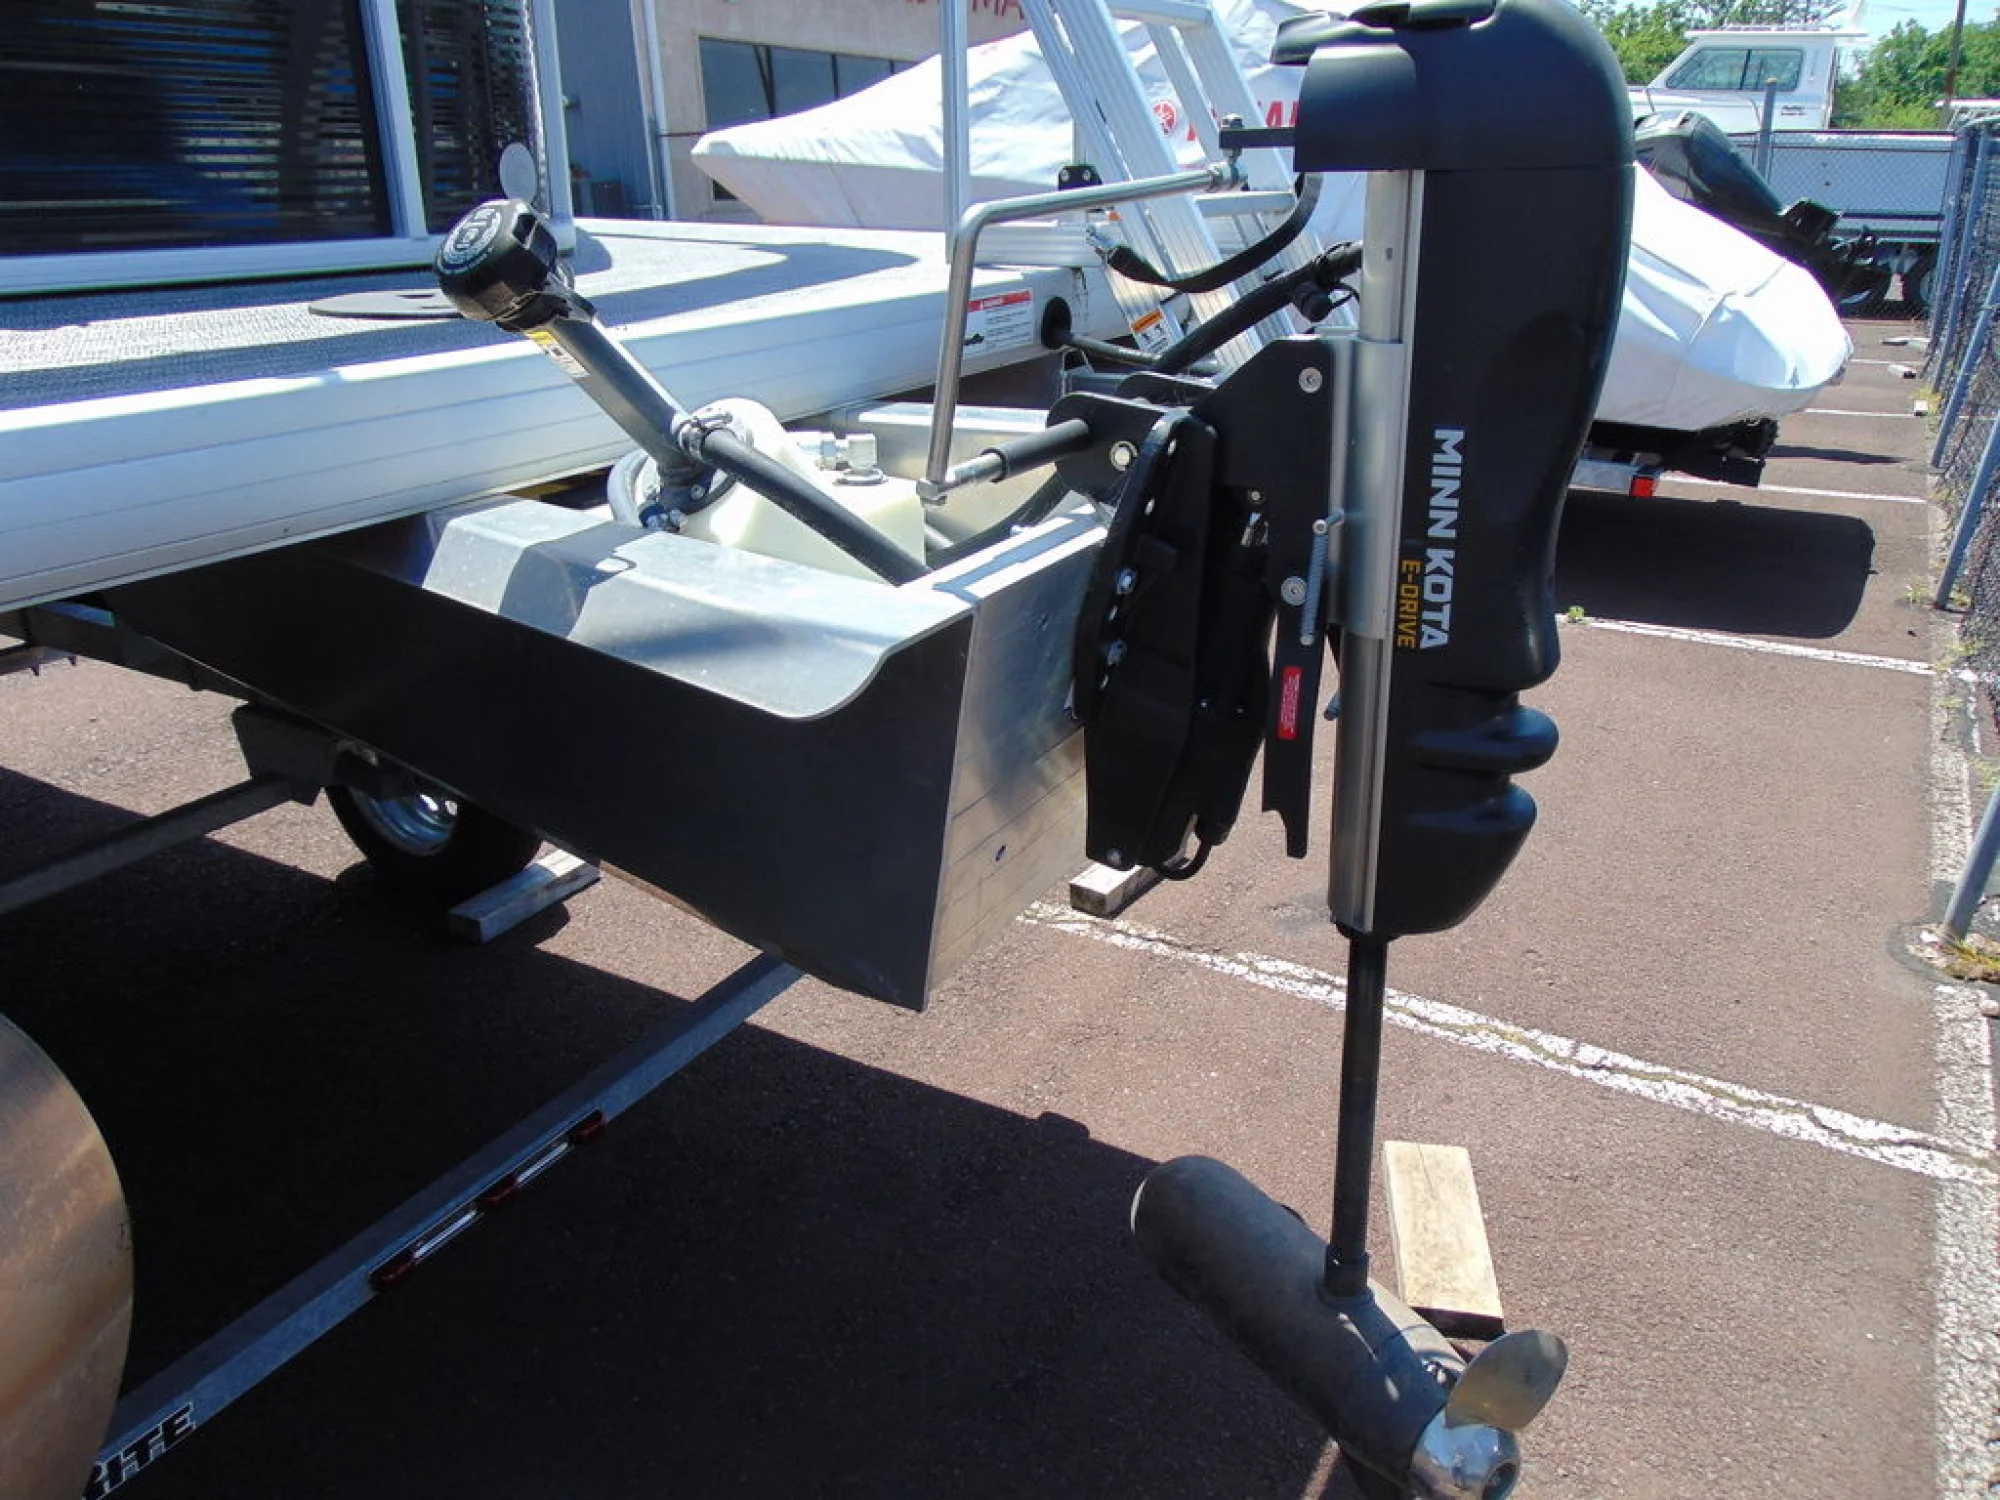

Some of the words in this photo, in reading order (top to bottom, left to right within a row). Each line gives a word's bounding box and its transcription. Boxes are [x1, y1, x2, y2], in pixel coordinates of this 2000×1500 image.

[1428, 429, 1465, 538] MINN
[1397, 559, 1421, 649] E-DRIVE
[1420, 549, 1456, 650] KOTA
